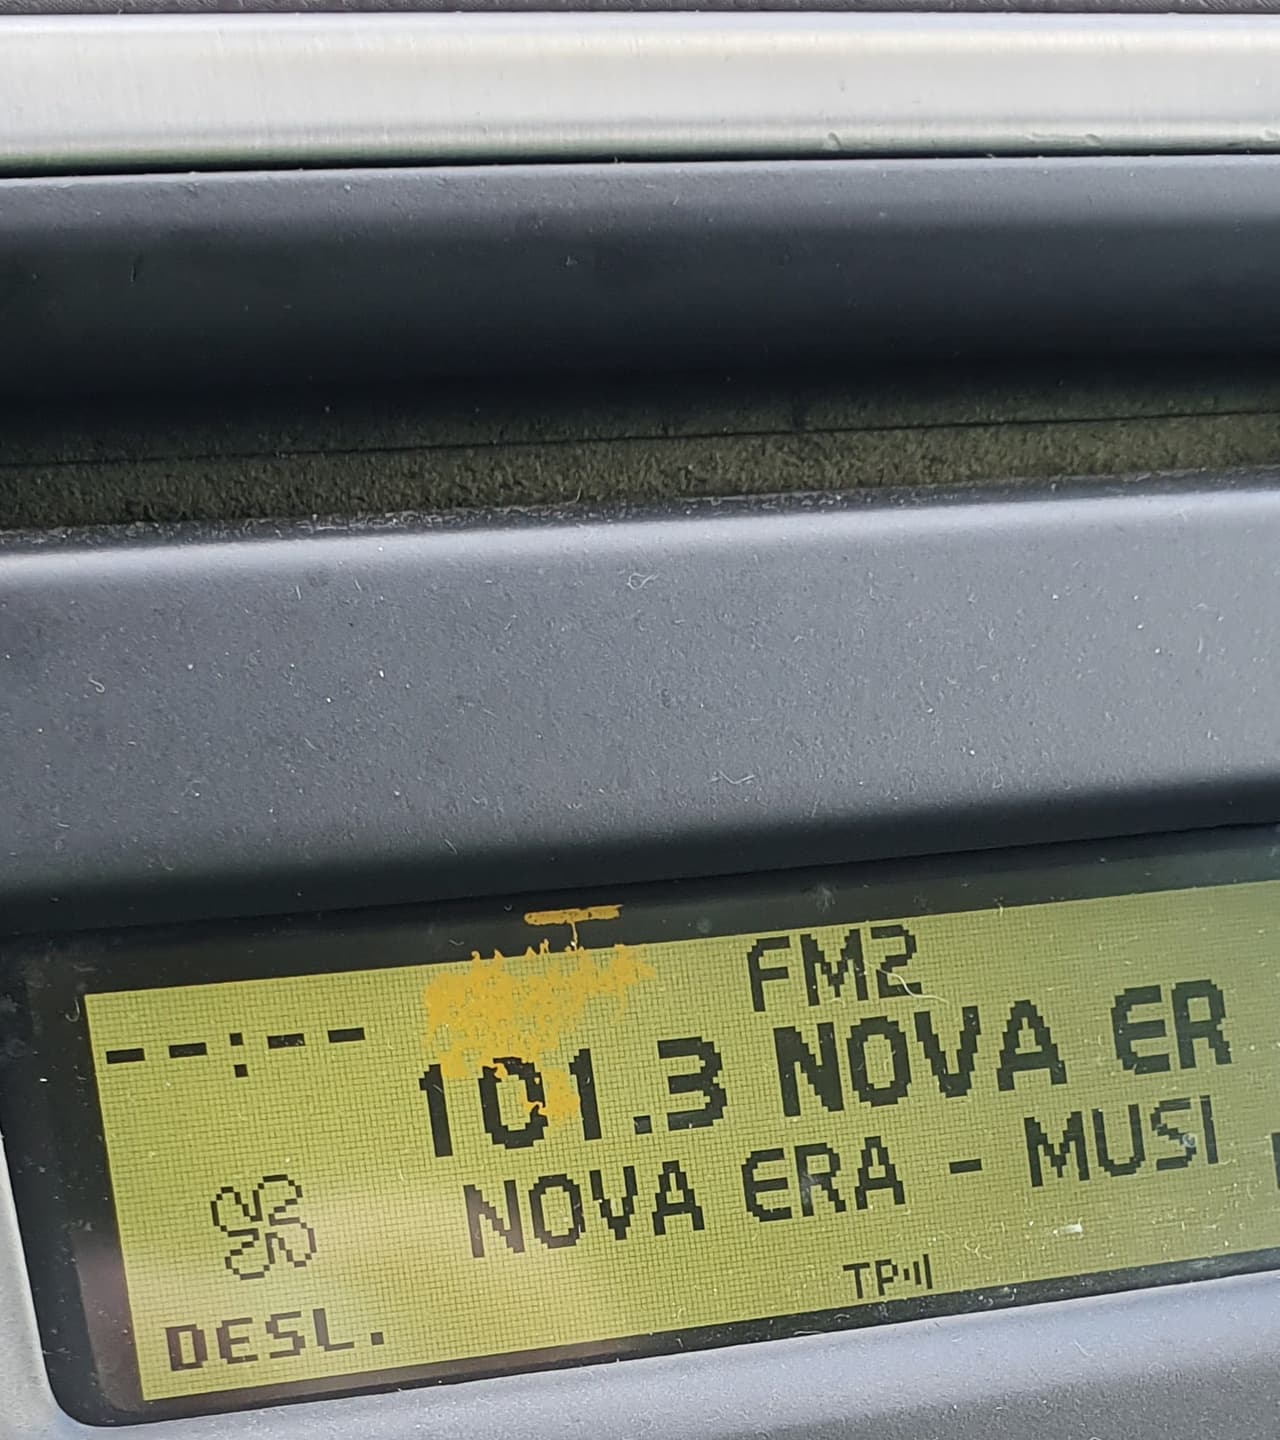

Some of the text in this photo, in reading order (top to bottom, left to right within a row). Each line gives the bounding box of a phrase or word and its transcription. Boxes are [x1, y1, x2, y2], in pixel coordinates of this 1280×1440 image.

[747, 924, 923, 1012] FM2
[419, 979, 1232, 1158] 101.3 NOVA ER
[463, 1160, 705, 1258] NOVA
[741, 1136, 906, 1222] ERA
[1023, 1094, 1219, 1187] MUSI
[166, 1307, 385, 1372] DESL.
